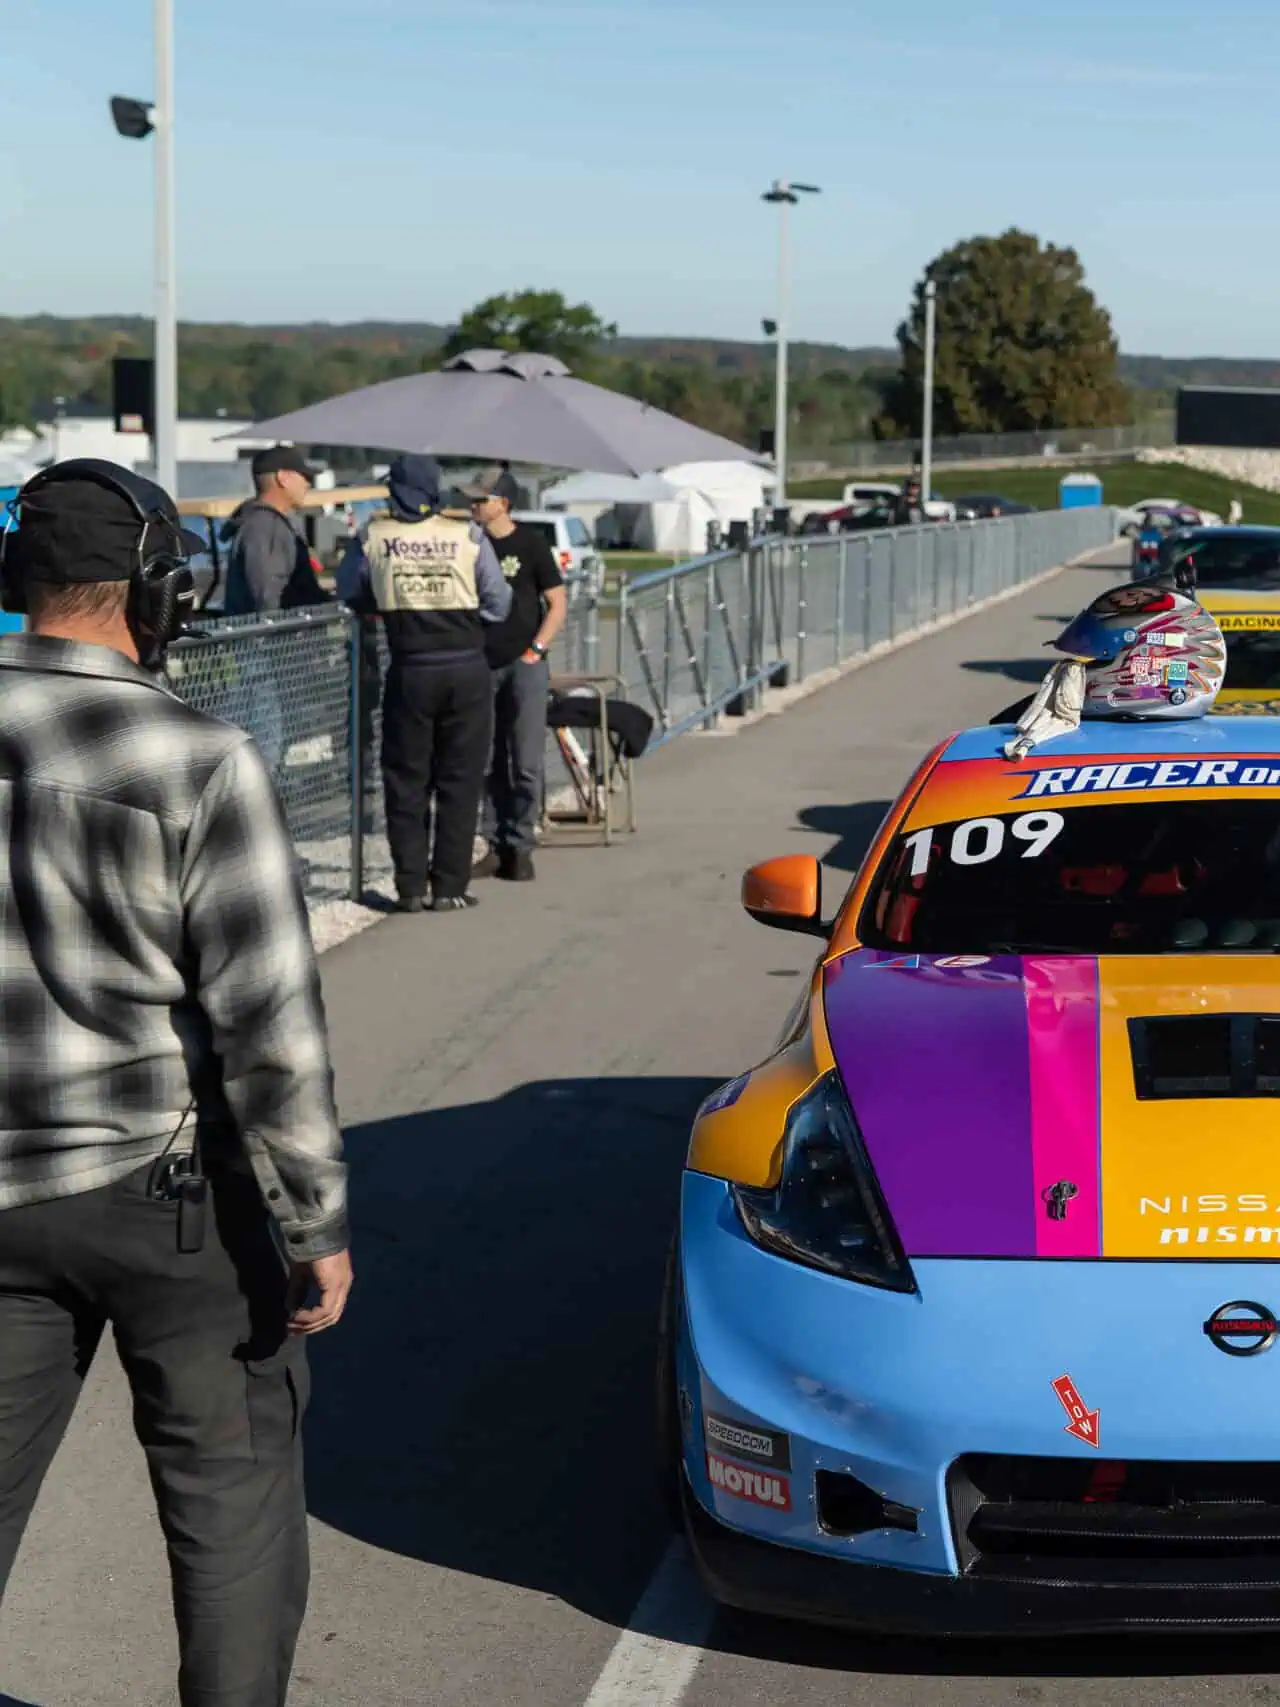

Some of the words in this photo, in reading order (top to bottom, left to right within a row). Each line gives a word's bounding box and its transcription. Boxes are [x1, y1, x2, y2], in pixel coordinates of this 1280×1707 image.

[1025, 760, 1240, 797] RACER
[904, 810, 1065, 876] 109
[1064, 1390, 1094, 1435] TOW
[708, 1421, 770, 1453] SPEEDCOM
[708, 1455, 786, 1505] MOTUL
